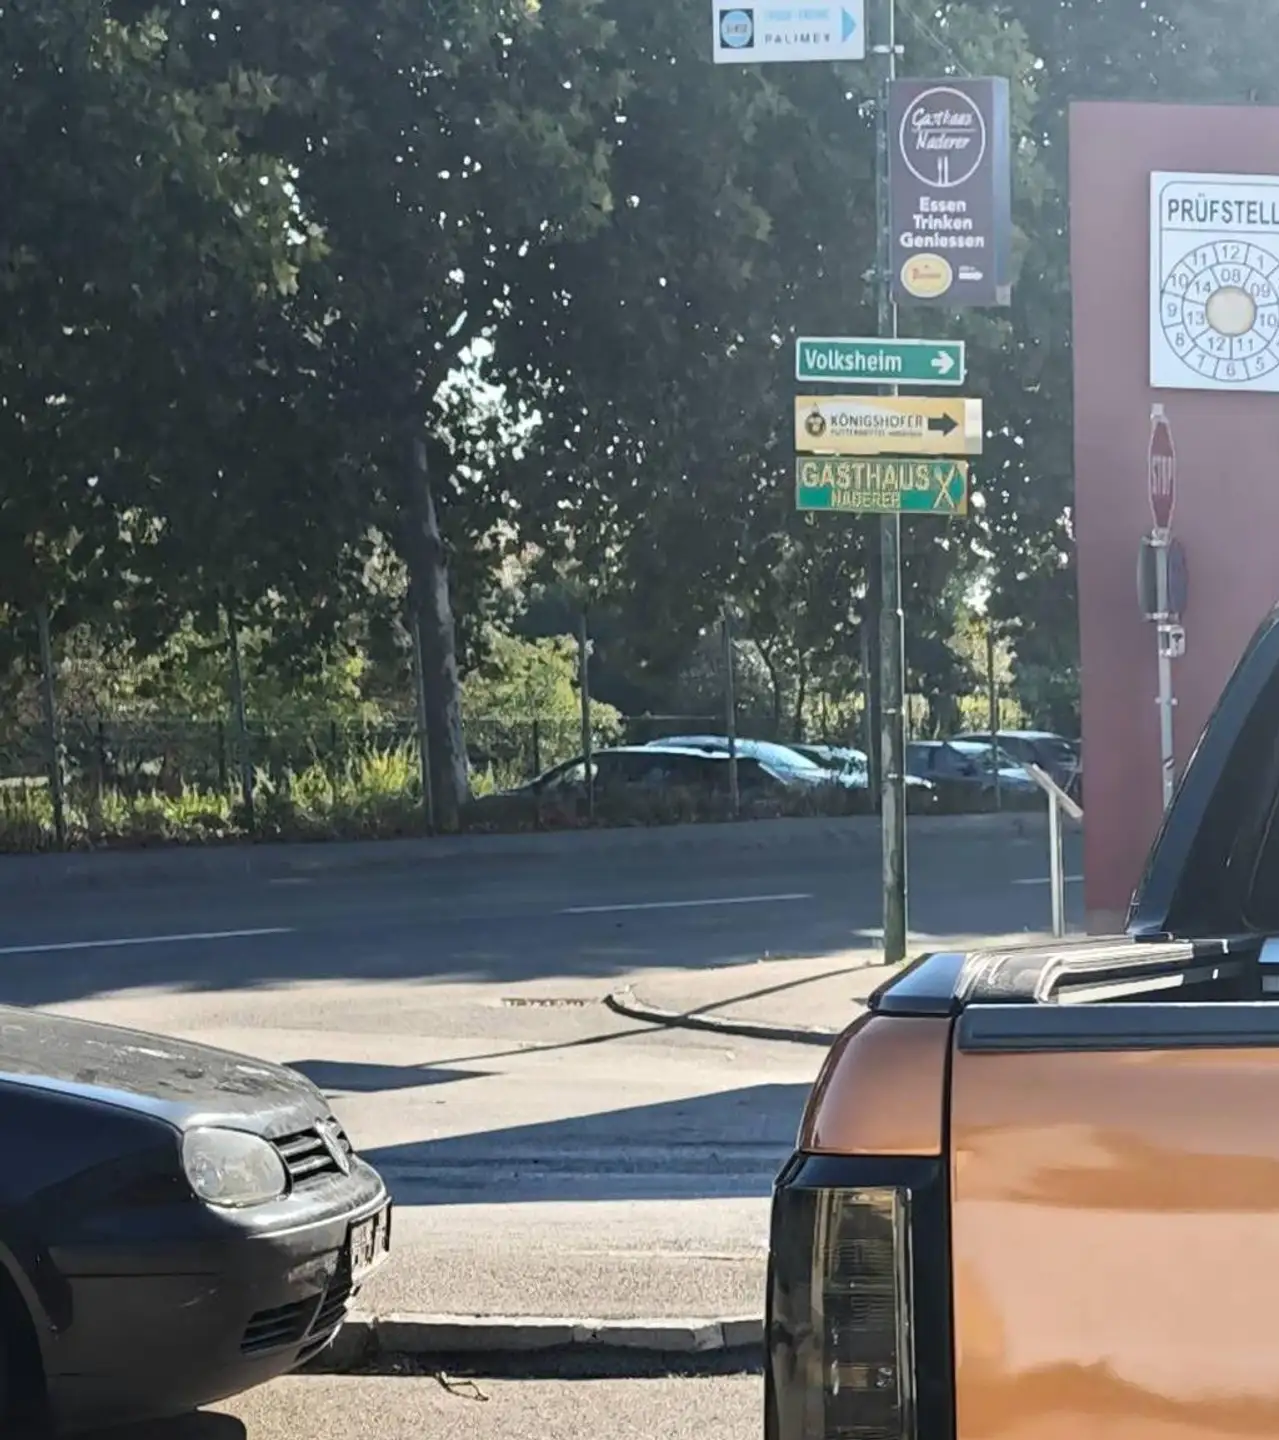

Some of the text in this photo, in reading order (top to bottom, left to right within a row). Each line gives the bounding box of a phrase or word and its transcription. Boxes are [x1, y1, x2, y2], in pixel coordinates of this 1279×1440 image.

[919, 196, 967, 213] Essen
[912, 213, 973, 230] Trinken
[900, 231, 985, 248] Geniessen
[1192, 250, 1207, 265] 11
[1222, 245, 1241, 260] 12
[1258, 254, 1265, 268] 1
[1171, 272, 1189, 289] 10
[1220, 268, 1241, 283] 08
[1195, 279, 1212, 294] 14
[1251, 283, 1271, 299] 09
[1166, 301, 1178, 318] 9
[1187, 310, 1205, 326] 13
[1260, 312, 1277, 328] 10
[1208, 336, 1225, 351] 12
[1237, 337, 1255, 351] 11
[804, 348, 902, 372] Volksheim
[1197, 354, 1209, 370] 7
[1255, 355, 1267, 371] 5
[1225, 361, 1236, 377] 6
[831, 412, 923, 429] KÖNIGSHOFER
[802, 461, 930, 491] GASTHAUS
